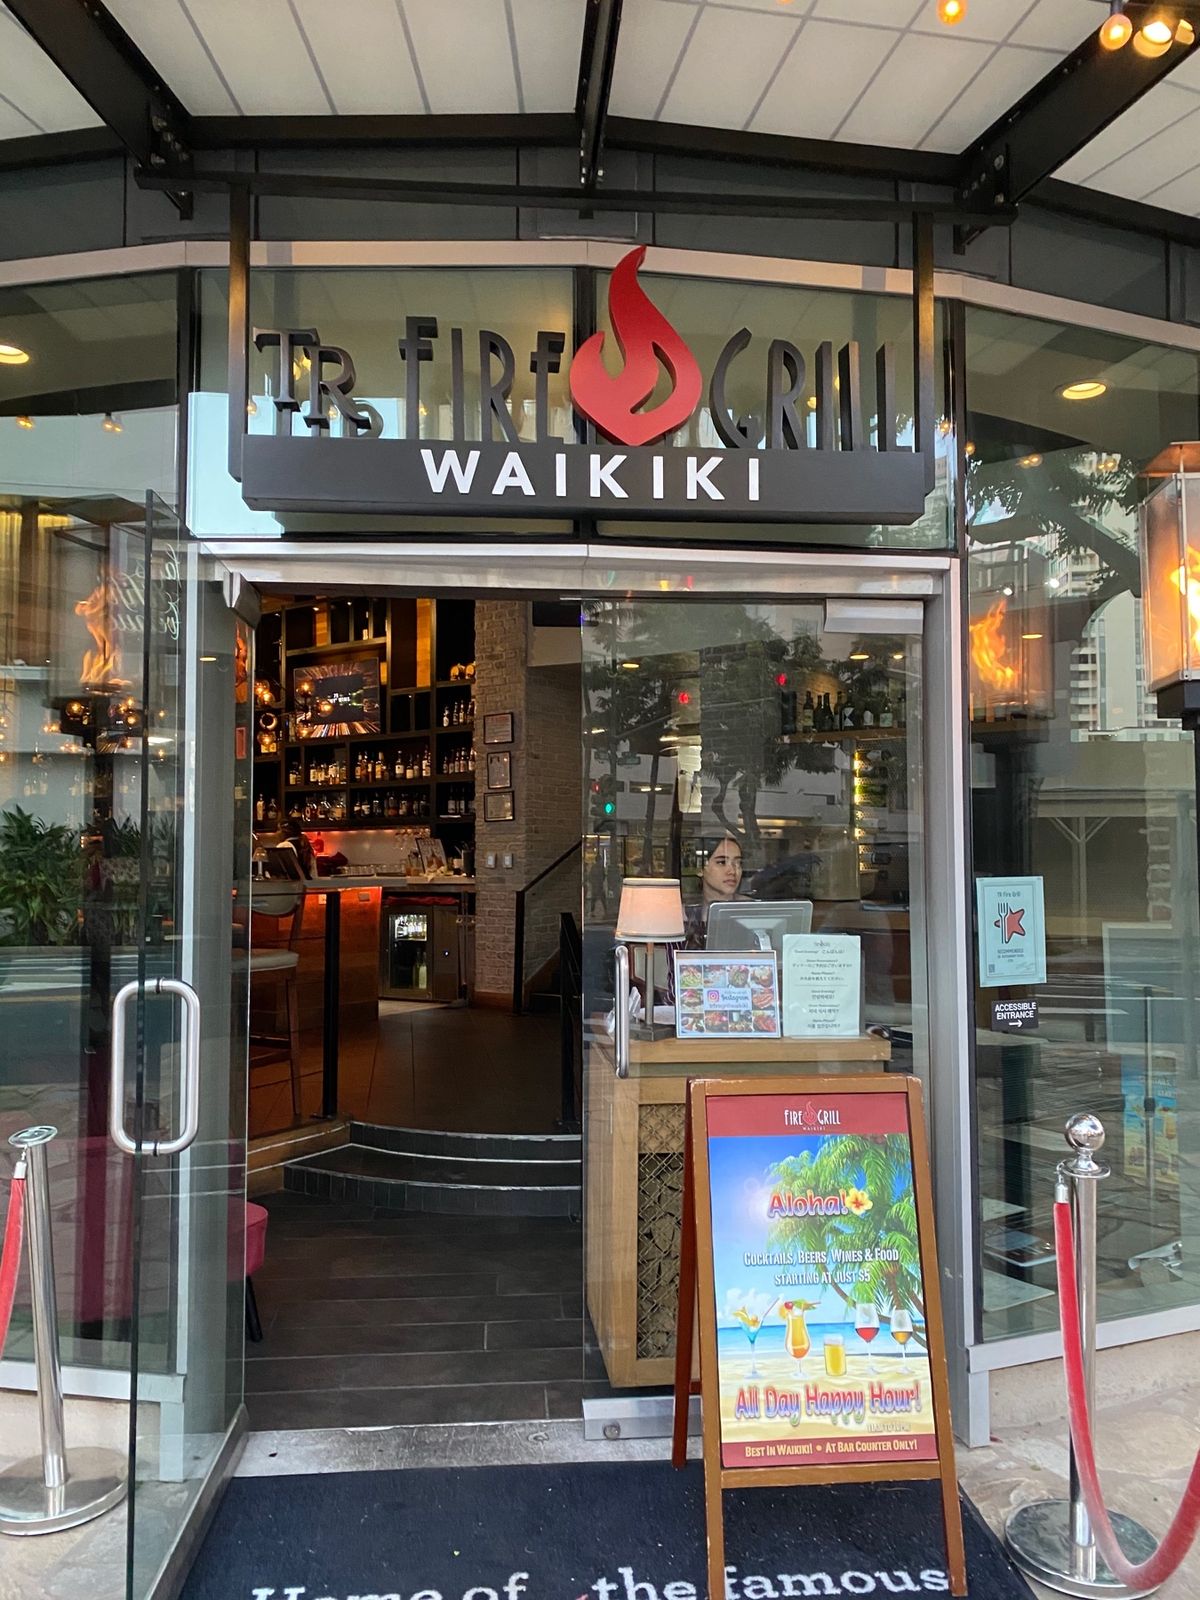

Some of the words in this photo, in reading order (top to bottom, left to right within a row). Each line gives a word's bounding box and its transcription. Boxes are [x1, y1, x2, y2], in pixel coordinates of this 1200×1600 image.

[399, 316, 566, 444] FIRE
[711, 327, 912, 451] GRILL
[420, 449, 760, 501] WAIKIKI
[994, 1002, 1037, 1012] ACCESSIBLE
[996, 1010, 1034, 1020] ENTRANCE
[784, 1109, 804, 1126] FIRE
[817, 1109, 841, 1125] GRILL
[767, 1189, 849, 1218] Aloha!
[743, 1251, 796, 1267] COCKTAILS,
[797, 1250, 830, 1265] BEERS,
[831, 1249, 863, 1263] WINES
[864, 1248, 874, 1262] &
[875, 1247, 899, 1261] FOOD
[774, 1271, 819, 1285] STARTING
[821, 1271, 833, 1284] AT
[834, 1270, 857, 1283] JUST
[858, 1269, 871, 1283] $5
[735, 1386, 760, 1419] All
[763, 1386, 801, 1426] Day
[805, 1383, 866, 1425] Happy
[869, 1380, 922, 1415] Hour!
[745, 1446, 765, 1458] BEST
[766, 1445, 776, 1457] IN
[777, 1443, 813, 1456] WAIKIKI!
[825, 1442, 837, 1453] AT
[837, 1441, 854, 1453] BAR
[855, 1440, 892, 1452] COUNTER
[893, 1438, 918, 1451] ONLY!
[463, 1572, 530, 1600] of
[591, 1567, 697, 1600] the
